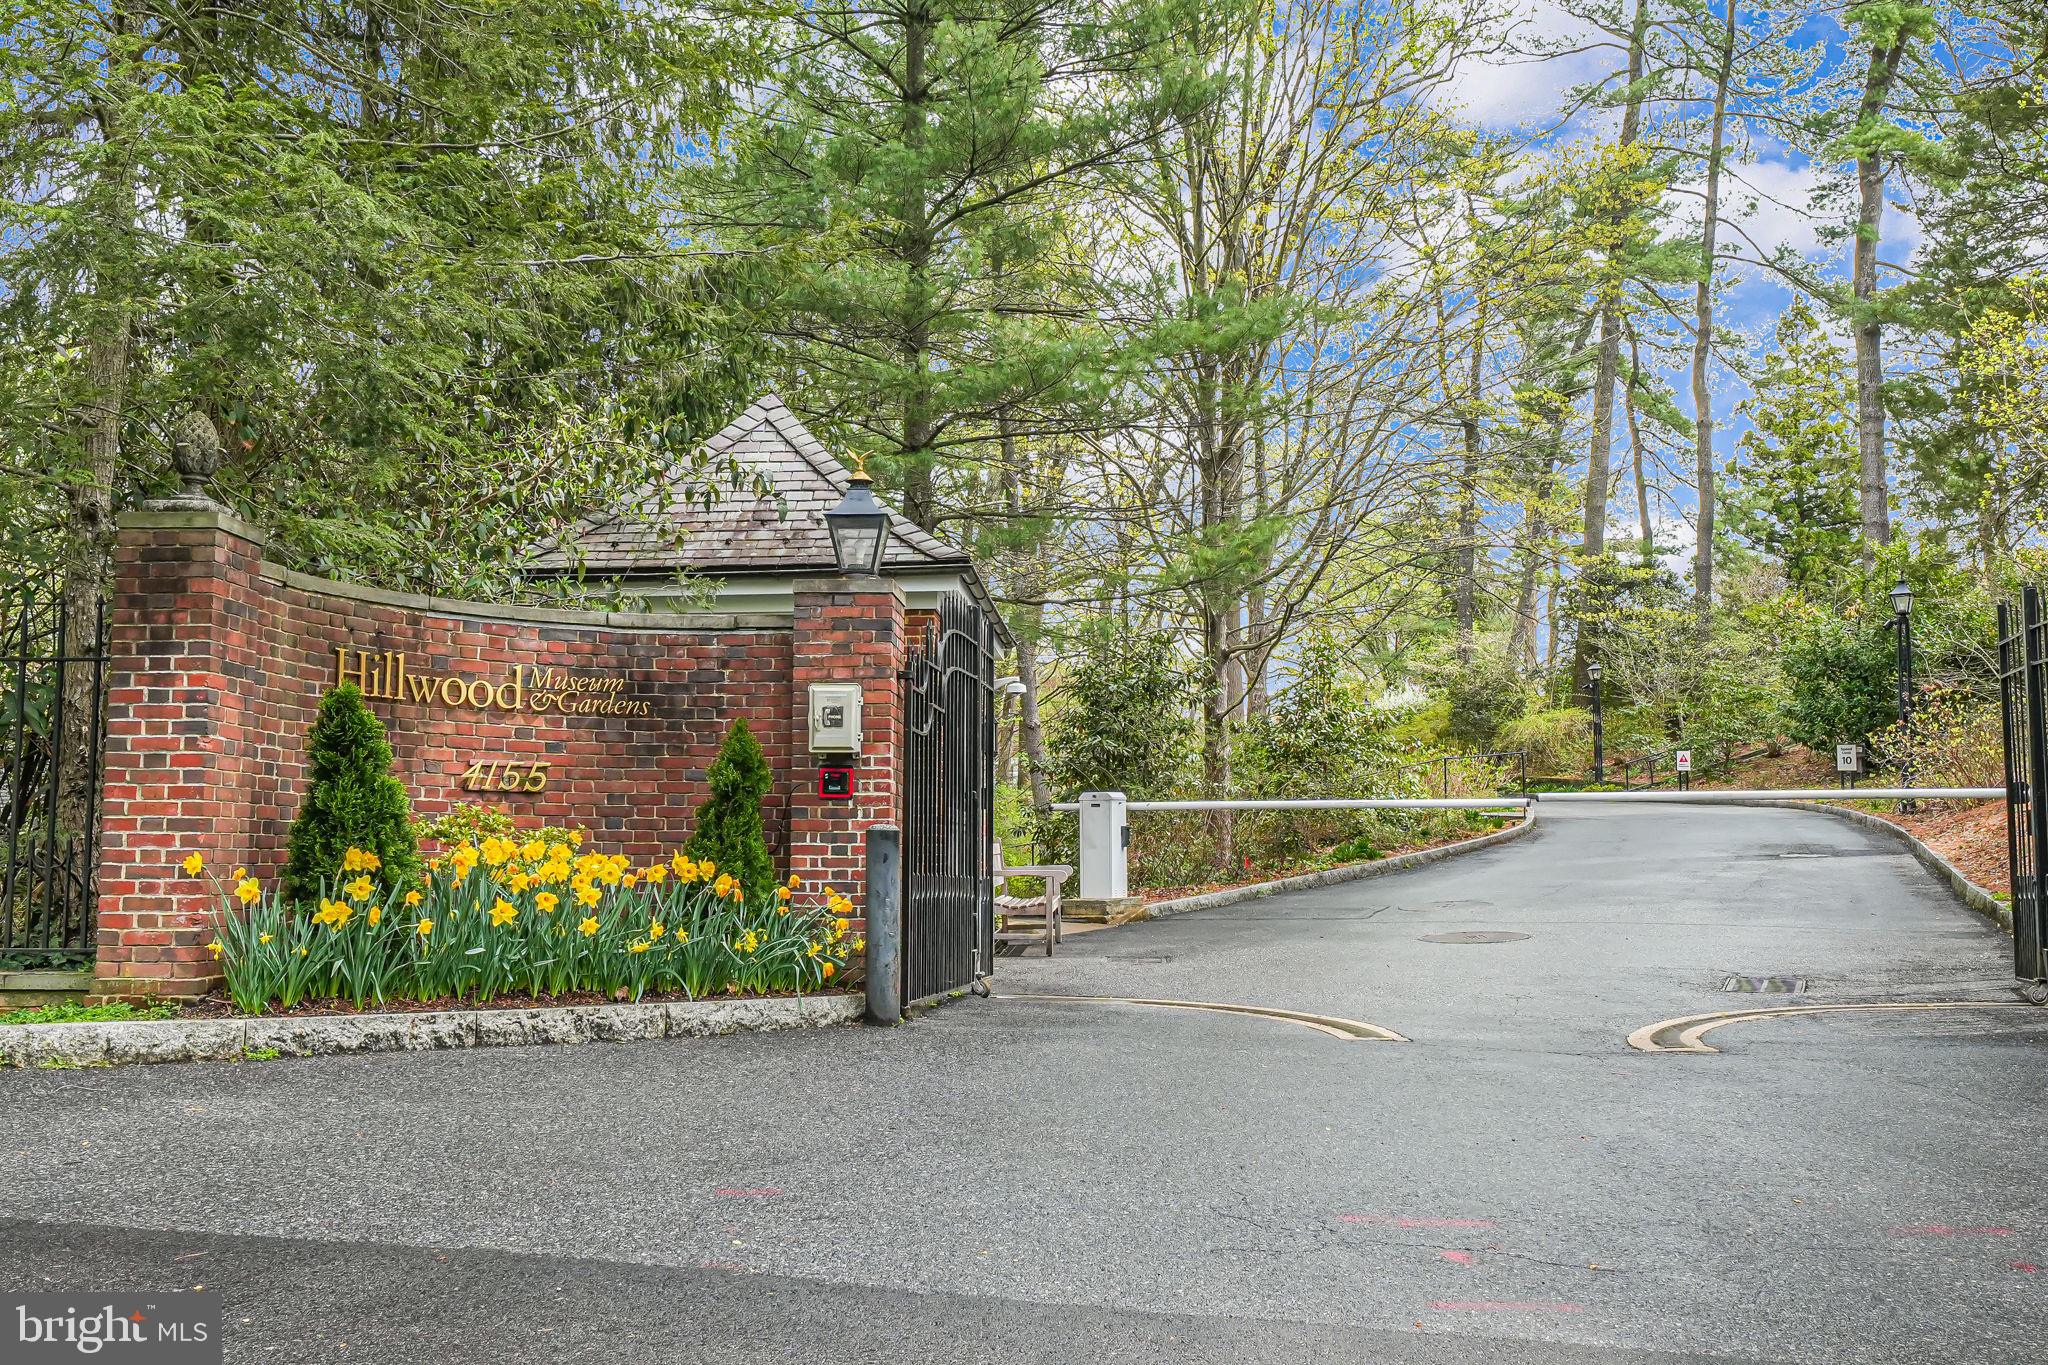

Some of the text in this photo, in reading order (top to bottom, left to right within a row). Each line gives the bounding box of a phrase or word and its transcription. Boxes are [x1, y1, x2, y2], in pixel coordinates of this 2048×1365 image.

[335, 647, 524, 710] Hillwood
[528, 666, 624, 693] Museum
[461, 759, 552, 792] 4155
[1841, 756, 1852, 765] 10
